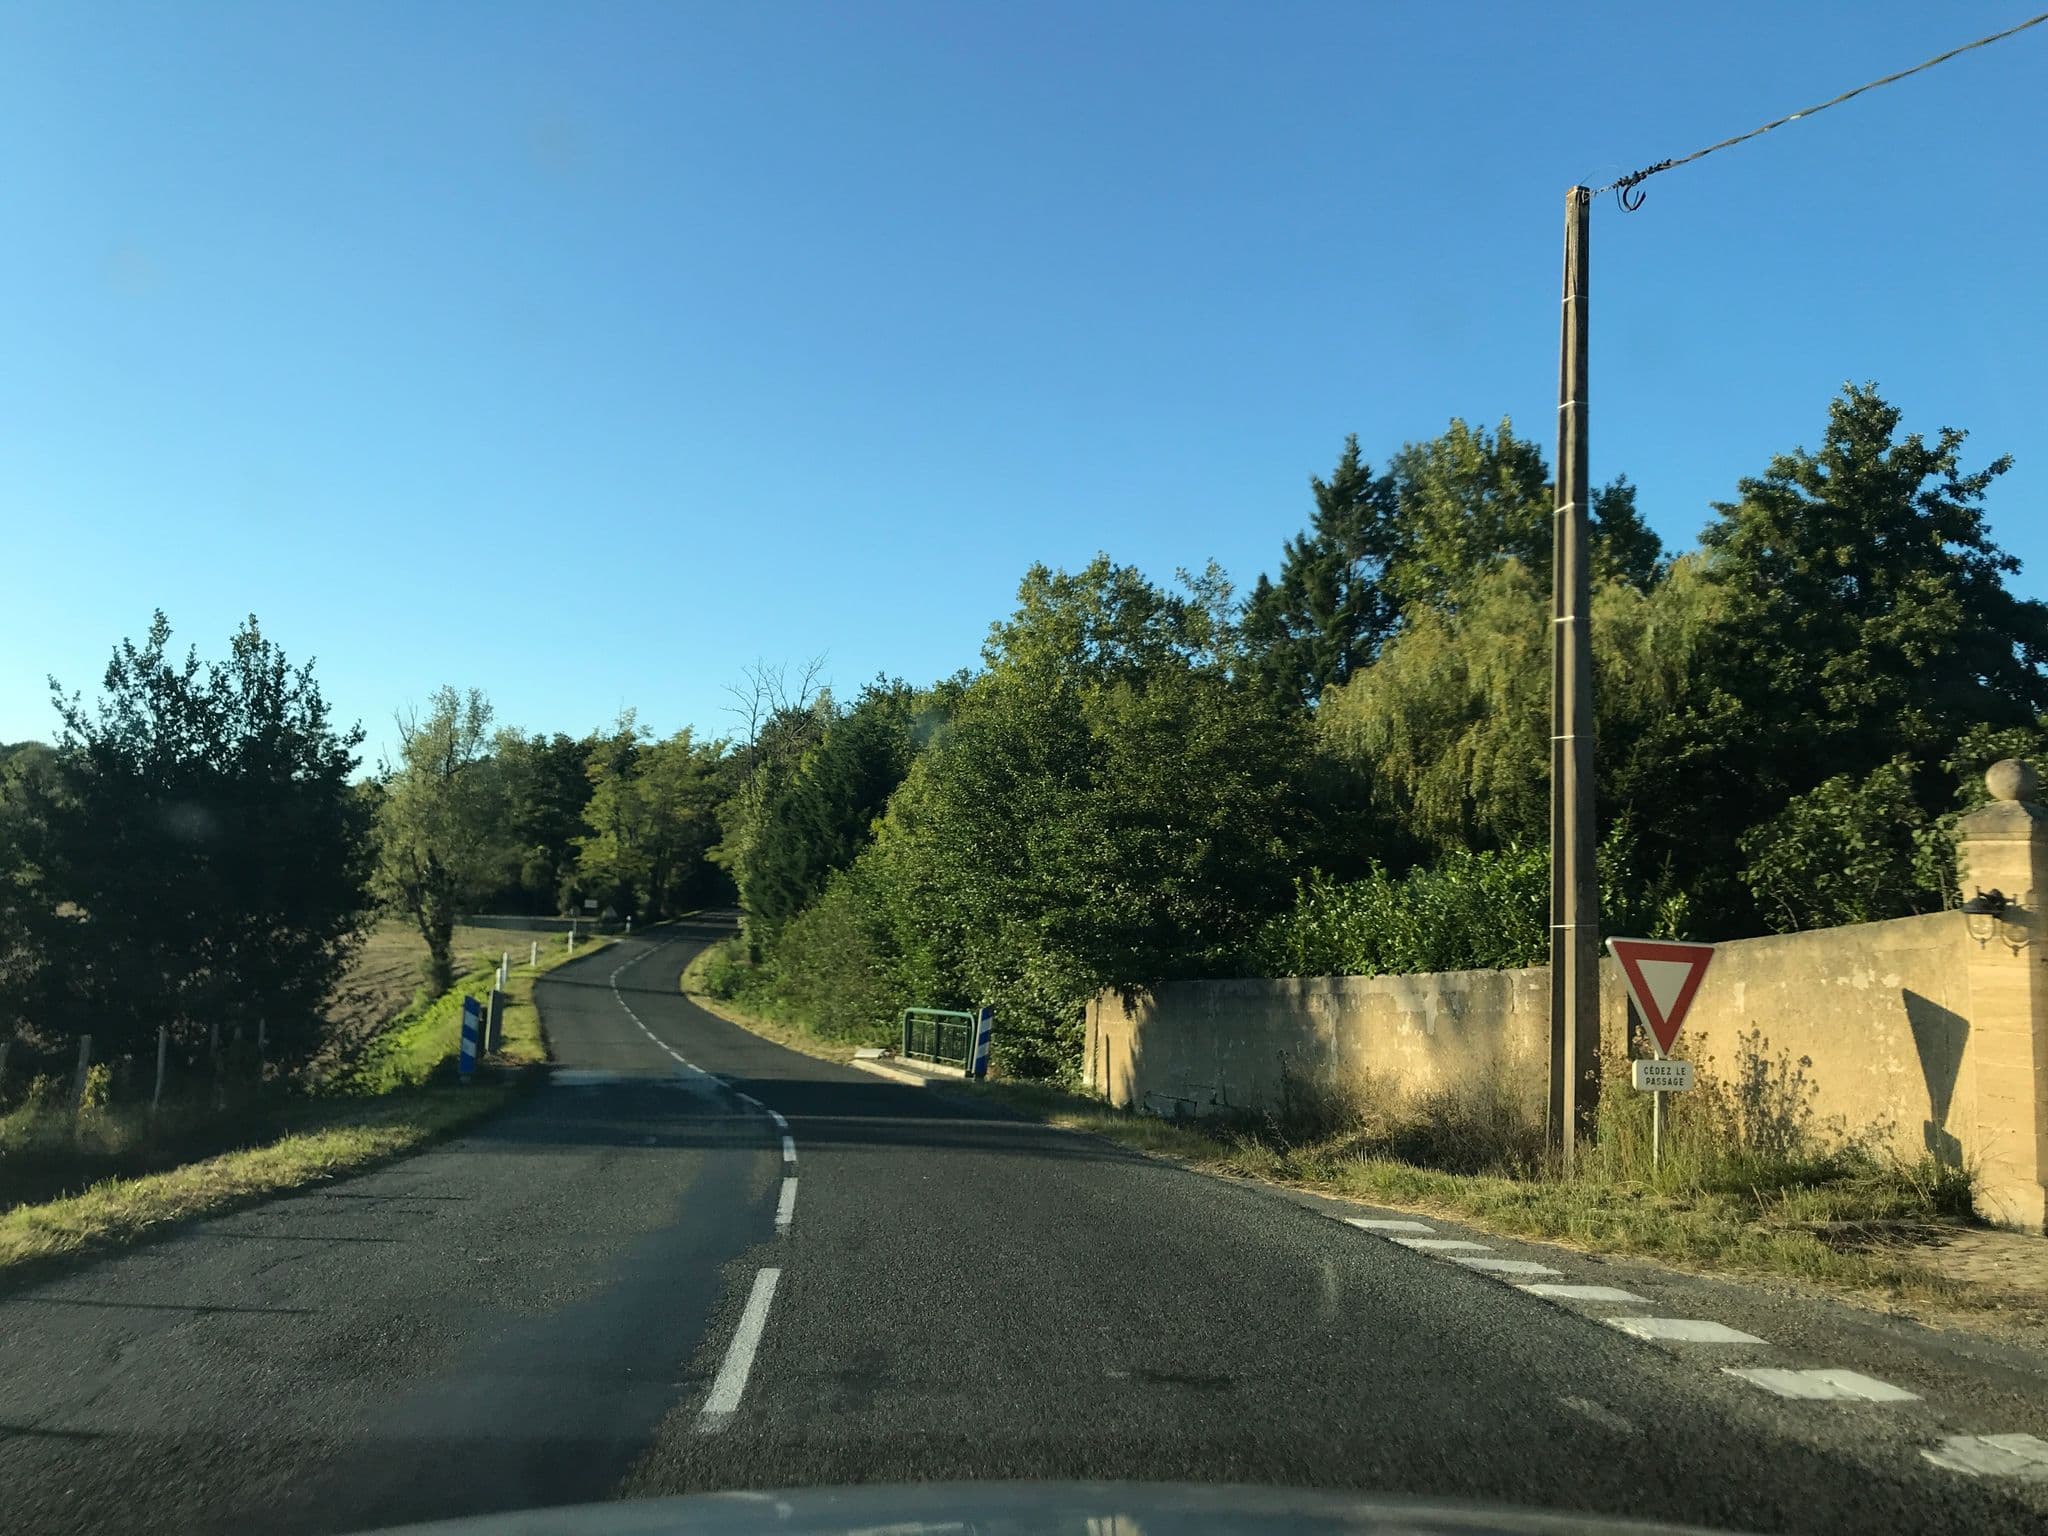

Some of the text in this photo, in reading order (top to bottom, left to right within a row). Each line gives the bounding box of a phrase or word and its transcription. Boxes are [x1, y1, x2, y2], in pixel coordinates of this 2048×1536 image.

[1643, 1065, 1686, 1076] CÉDEZ LE
[1645, 1077, 1684, 1086] PASSAGE
